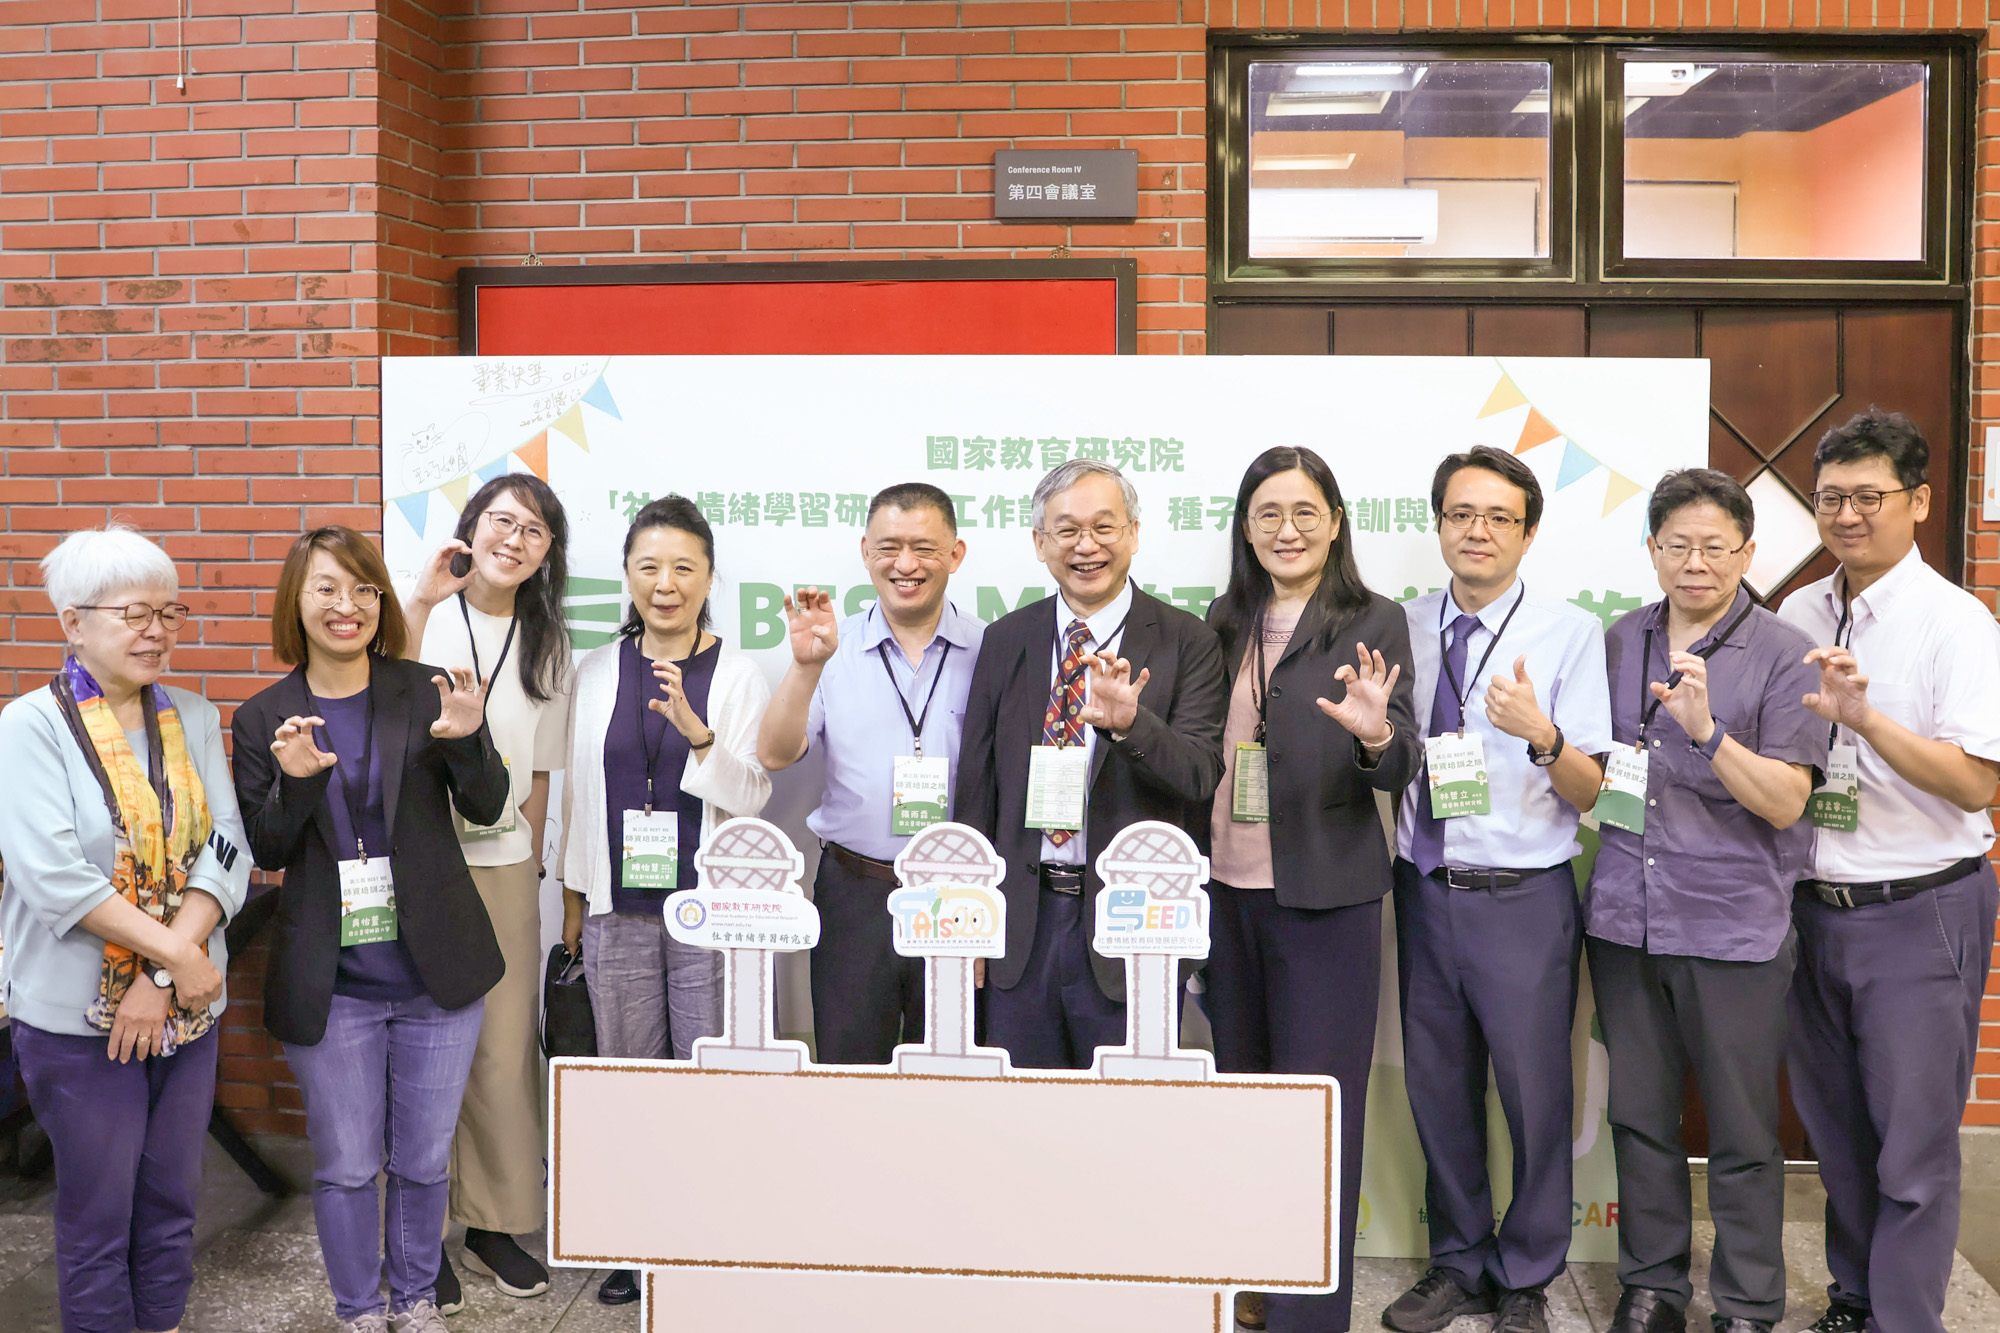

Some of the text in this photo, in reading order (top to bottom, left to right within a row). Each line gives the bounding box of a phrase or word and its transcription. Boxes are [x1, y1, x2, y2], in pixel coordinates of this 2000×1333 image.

[1008, 166, 1050, 174] Conference
[1051, 166, 1073, 174] Room
[1008, 184, 1097, 201] 第四會議室
[926, 435, 1184, 473] 國家教育研究院
[711, 901, 783, 913] 國家教育研究院
[711, 931, 812, 945] 社會情緒學習研究室
